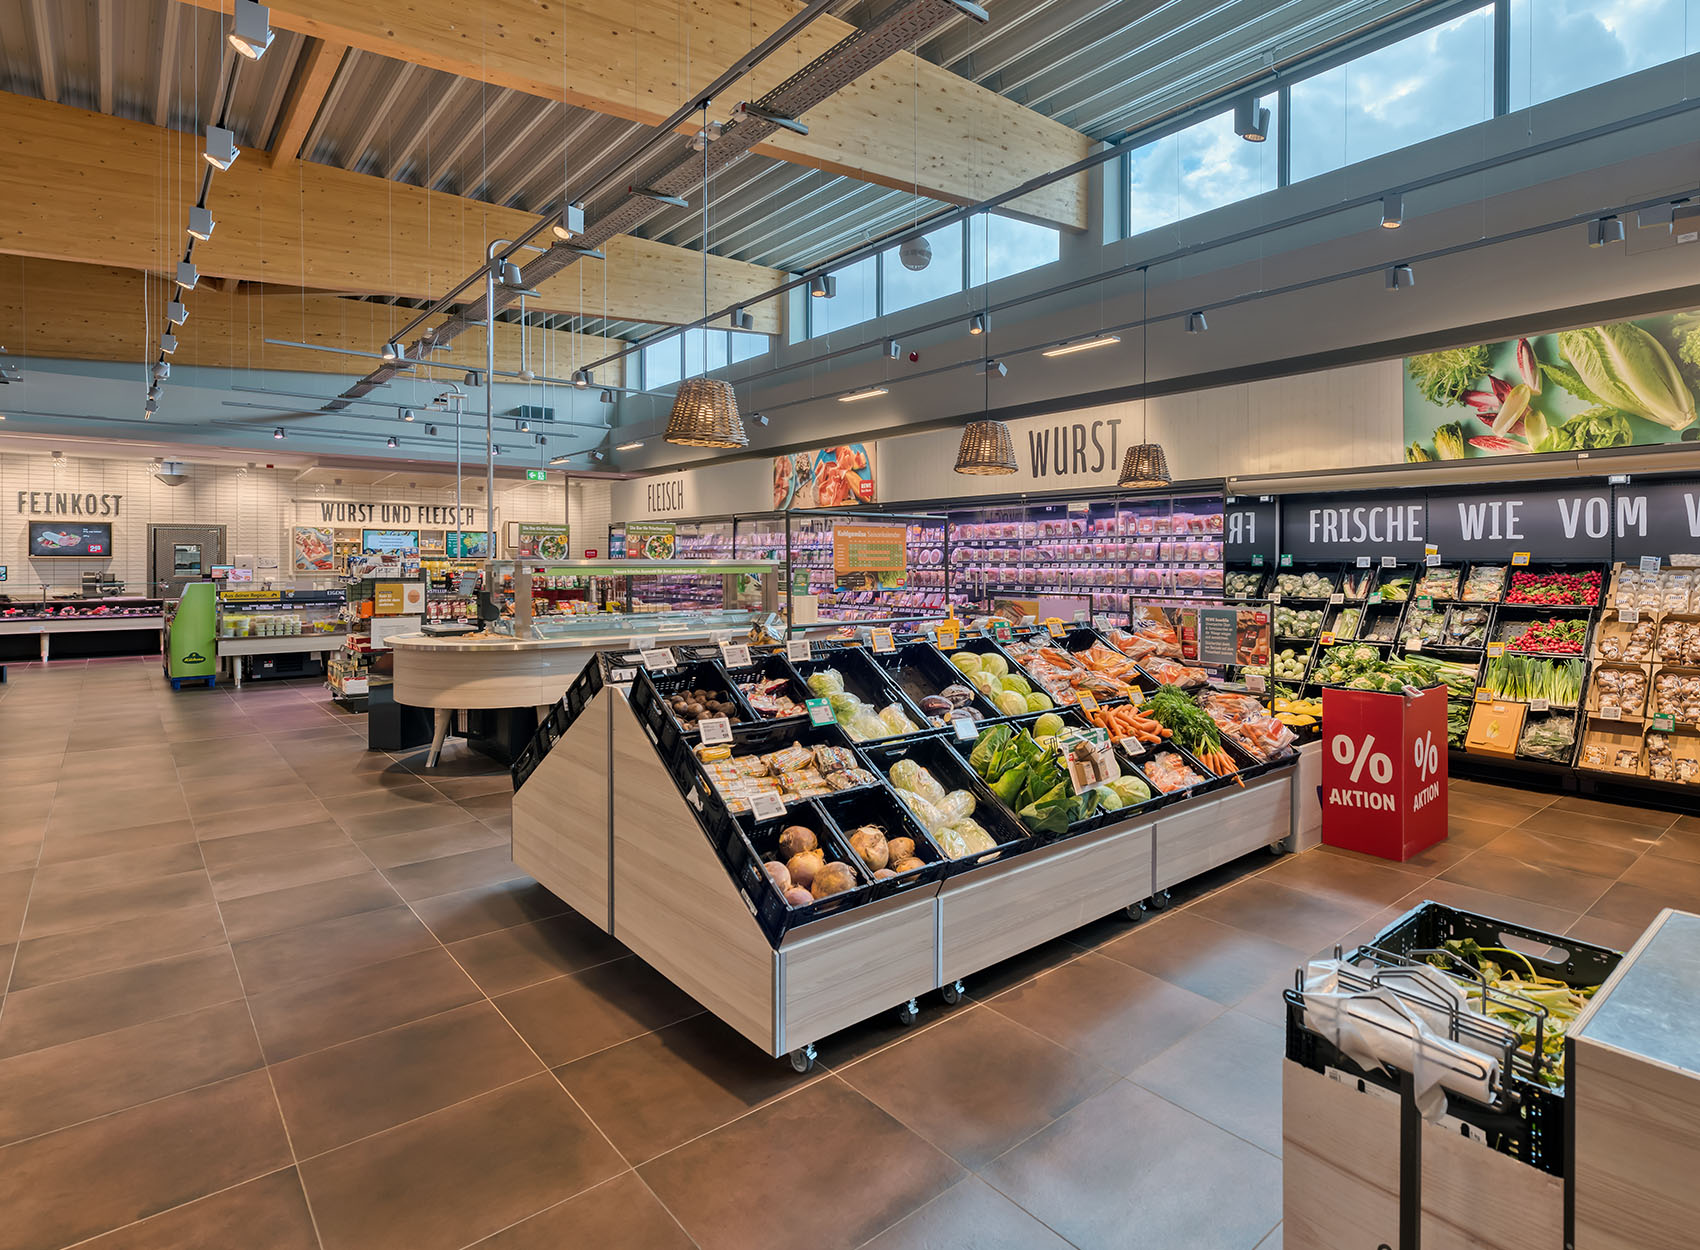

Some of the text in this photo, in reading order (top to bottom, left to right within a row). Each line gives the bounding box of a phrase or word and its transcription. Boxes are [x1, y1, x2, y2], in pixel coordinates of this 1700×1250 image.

[1029, 418, 1121, 478] WURST
[17, 491, 123, 516] FEINKOST
[647, 479, 684, 512] FLEISCH
[321, 502, 474, 525] WURST UND FLEISCH
[1309, 505, 1423, 543] FRISCHE
[1458, 500, 1524, 541] WIE
[1557, 496, 1648, 539] VOM
[1331, 734, 1393, 784] %
[1414, 730, 1438, 782] %
[1329, 788, 1396, 812] AKTION
[1413, 781, 1440, 812] AKTION
